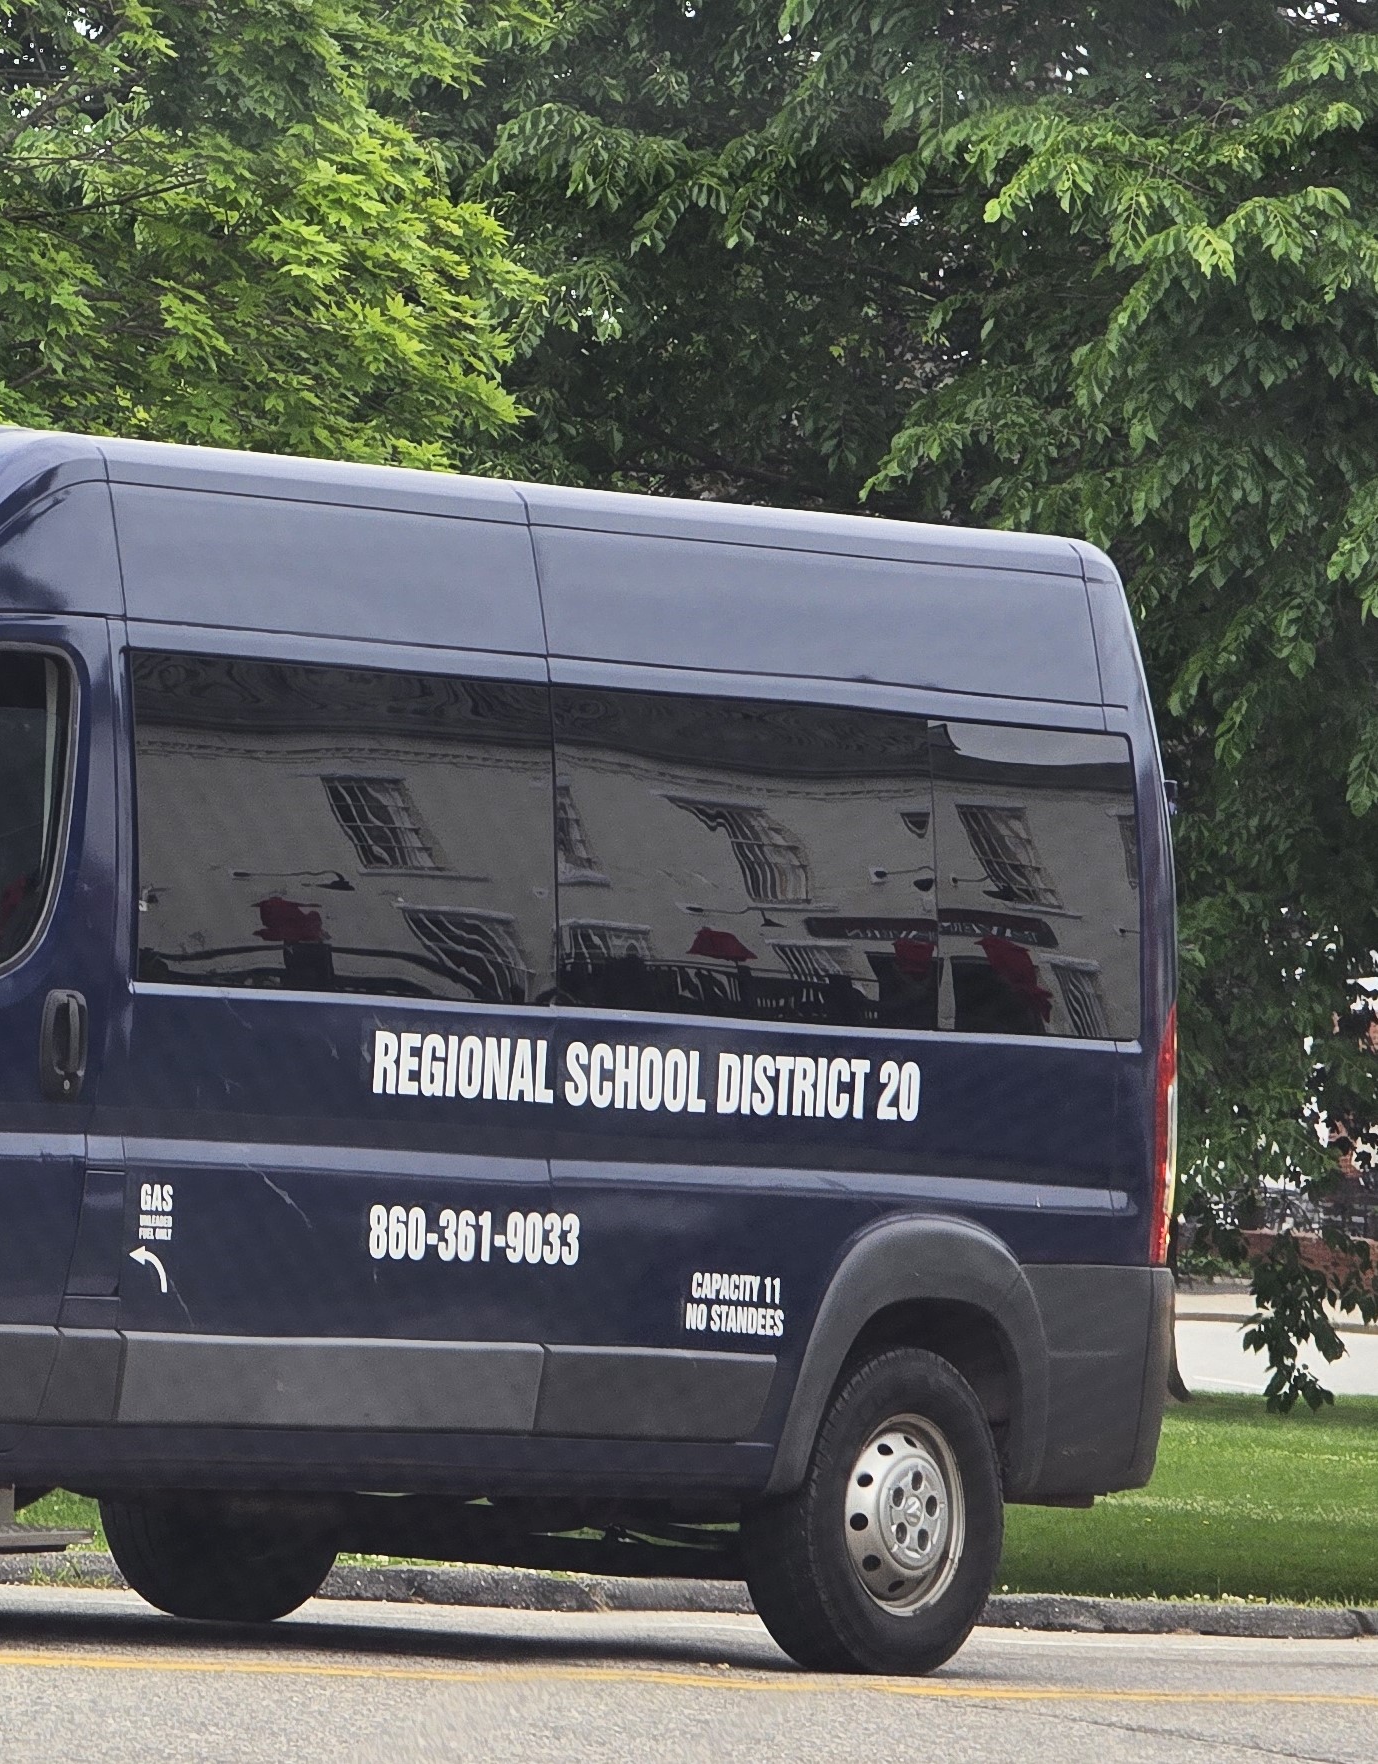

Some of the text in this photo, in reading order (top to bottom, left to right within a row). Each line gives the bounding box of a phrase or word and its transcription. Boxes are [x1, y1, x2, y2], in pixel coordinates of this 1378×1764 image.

[372, 1030, 920, 1122] REGIONAL SCHOOL DISTRICT 20
[140, 1183, 174, 1212] GAS
[369, 1204, 580, 1266] 860-361-9033
[691, 1271, 781, 1304] CAPACITY 11
[685, 1302, 785, 1337] NO STANDEES
